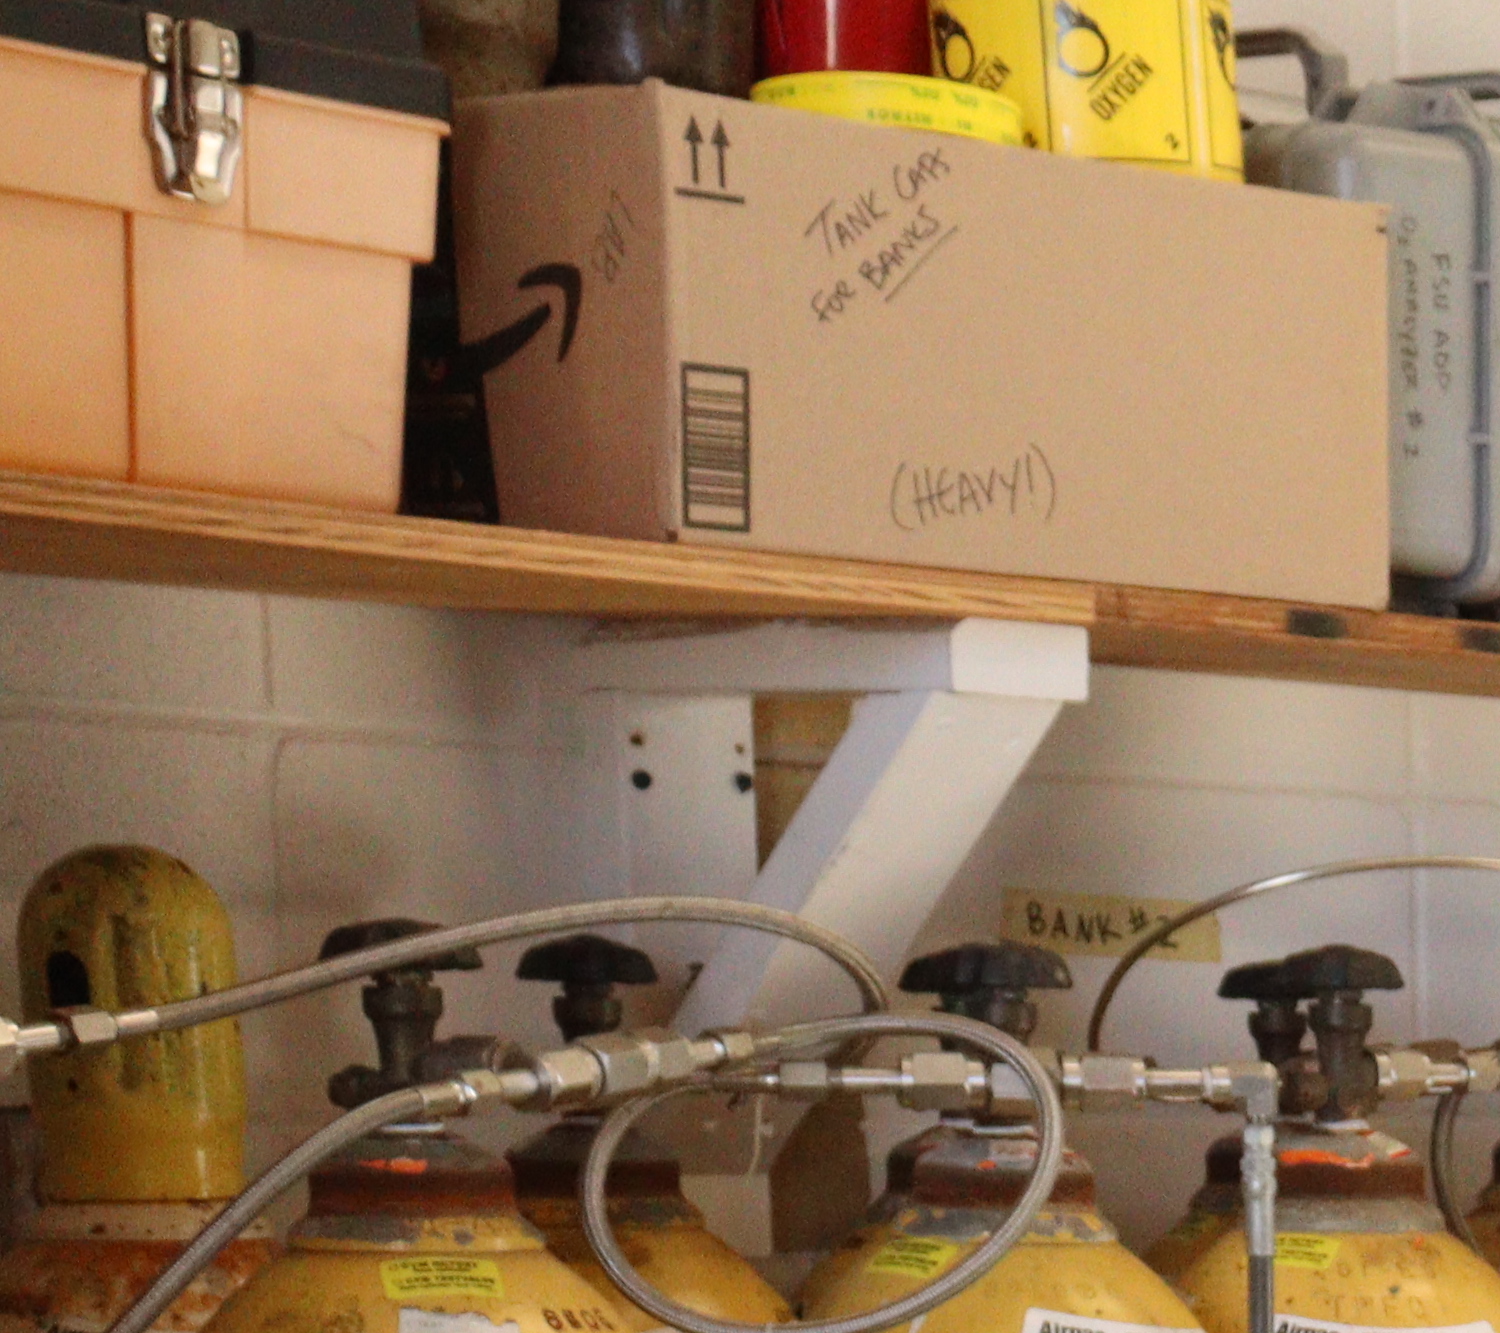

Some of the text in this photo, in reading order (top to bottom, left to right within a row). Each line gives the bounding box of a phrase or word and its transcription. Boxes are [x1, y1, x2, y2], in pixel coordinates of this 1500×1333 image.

[1090, 55, 1154, 121] OXYGEN
[1165, 132, 1180, 150] 2
[805, 187, 890, 258] TANK
[858, 203, 942, 292] BANKS
[1431, 252, 1452, 312] FSU
[1026, 900, 1123, 945] BANK
